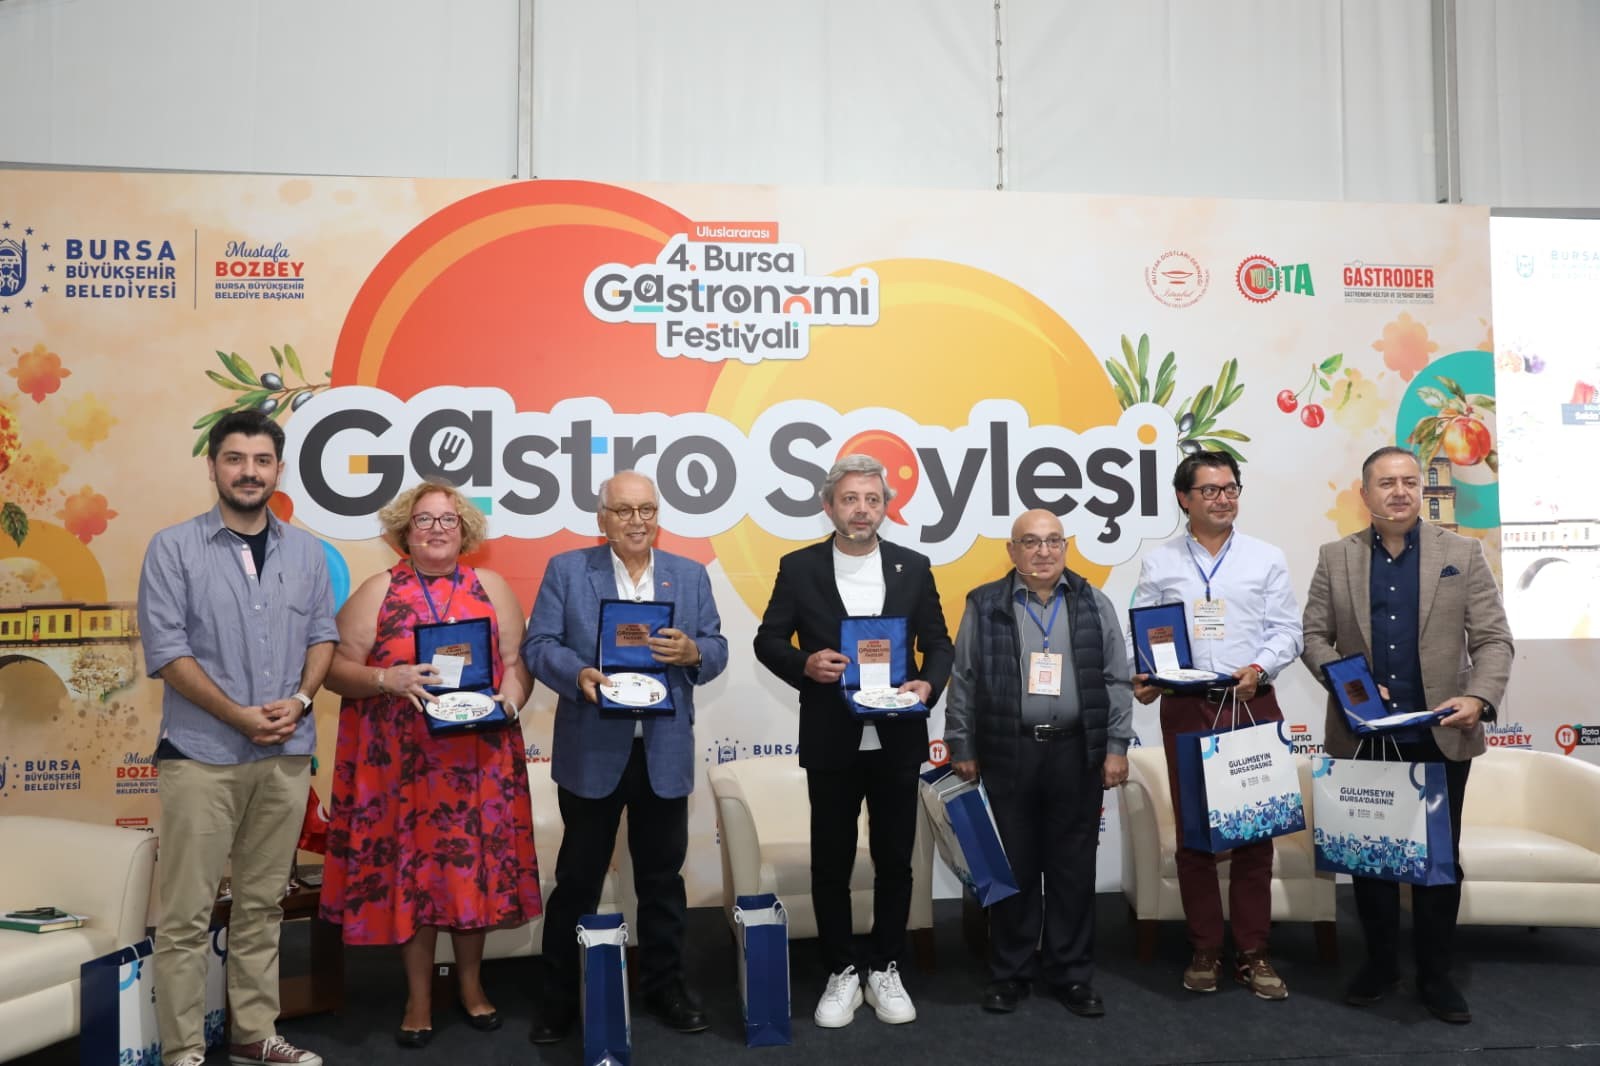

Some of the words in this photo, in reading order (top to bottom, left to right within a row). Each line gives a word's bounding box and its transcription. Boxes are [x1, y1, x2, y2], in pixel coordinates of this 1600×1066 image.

[696, 225, 771, 239] Uluslararası
[66, 239, 176, 261] BURSA
[225, 241, 290, 263] Mustafa
[667, 244, 697, 272] 4.
[704, 244, 794, 273] Bursa
[66, 262, 176, 281] BÜYÜKŞEHİR
[216, 261, 305, 277] BOZBEY
[1343, 267, 1434, 288] GASTRODER
[66, 281, 176, 299] BELEDİYESİ
[215, 282, 246, 290] BURSA
[248, 281, 304, 291] BÜYÜKŞEHİR
[215, 289, 260, 300] BELEDİYE
[263, 291, 305, 301] BAŞKANI
[666, 320, 799, 354] Festivali
[299, 408, 737, 517] Gastro
[1485, 734, 1532, 747] OZBEY
[25, 760, 81, 771] BURSA
